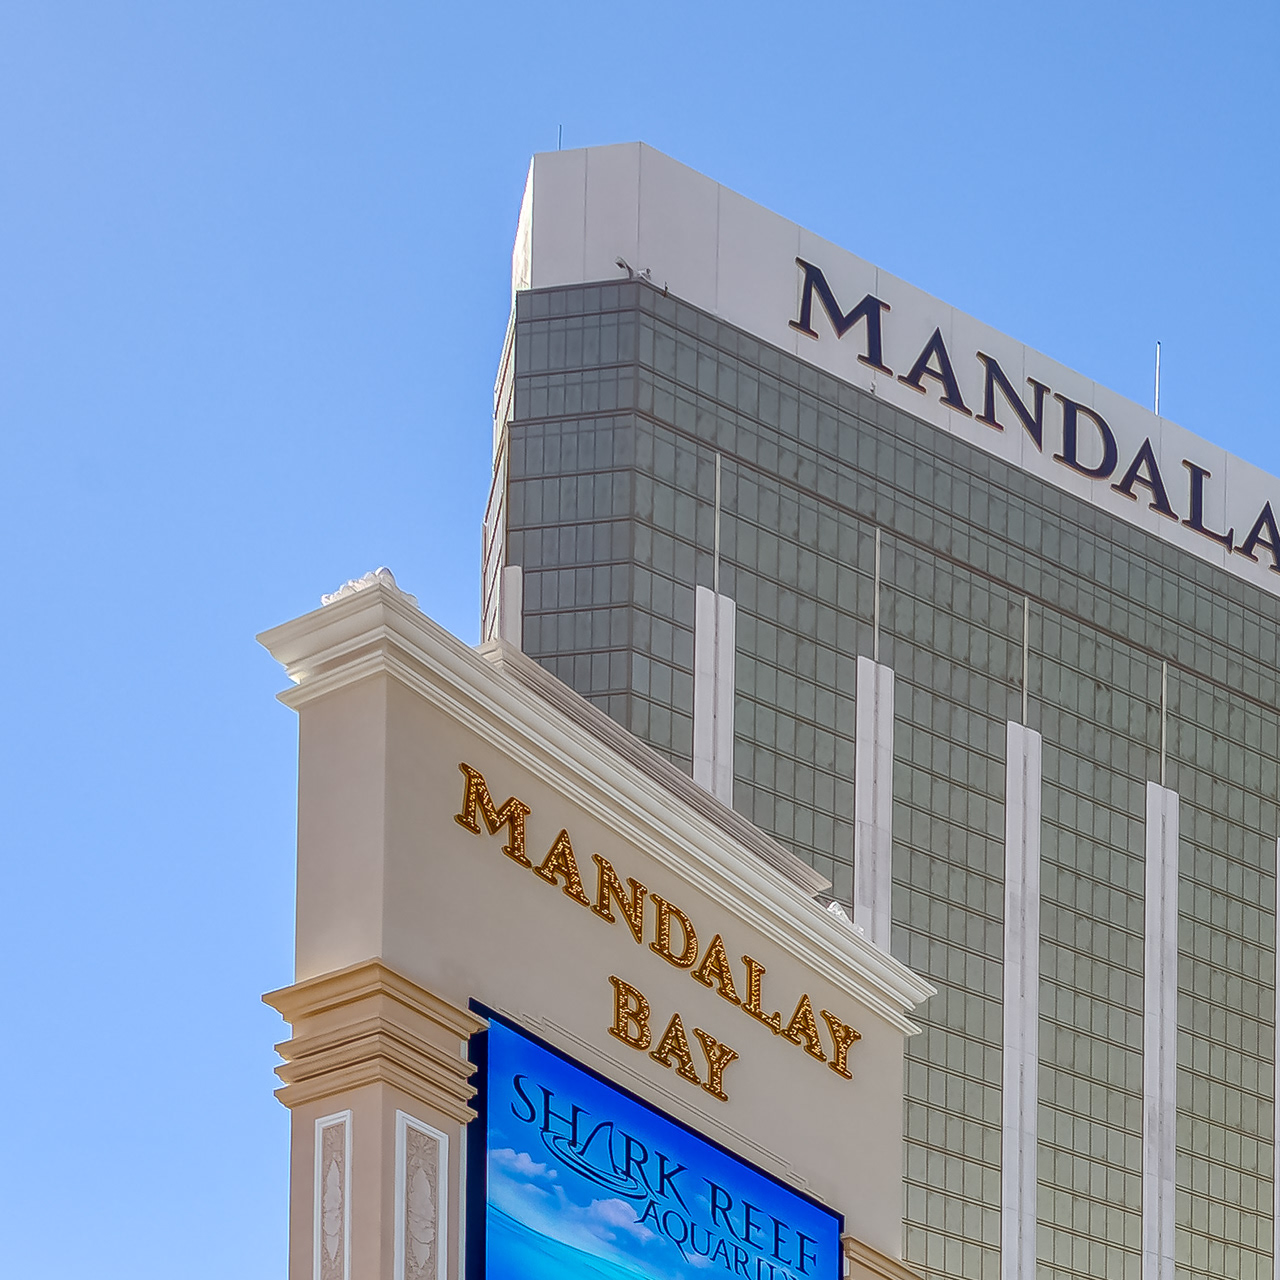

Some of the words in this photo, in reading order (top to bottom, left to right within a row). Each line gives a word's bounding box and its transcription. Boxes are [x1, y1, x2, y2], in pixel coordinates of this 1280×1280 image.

[454, 762, 862, 1080] MANDALAY
[607, 975, 739, 1102] BAY
[510, 1073, 692, 1217] SHARK
[702, 1176, 819, 1276] REEF
